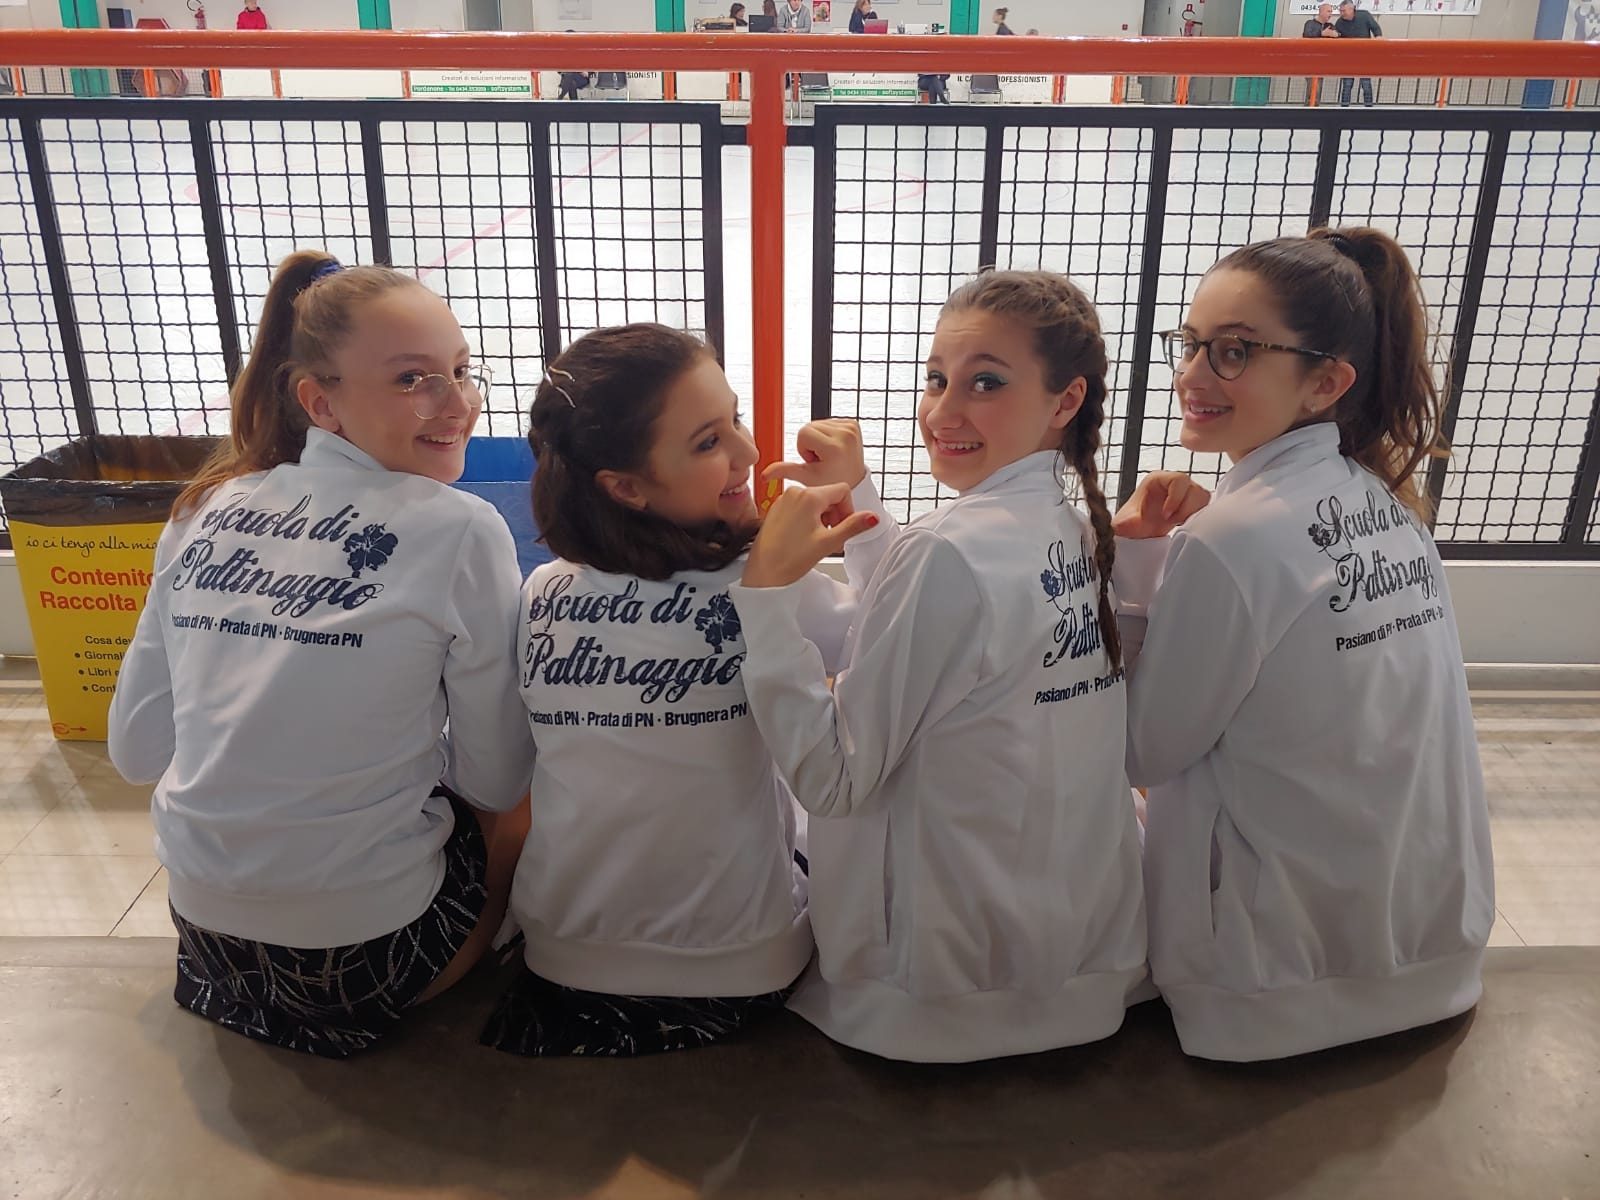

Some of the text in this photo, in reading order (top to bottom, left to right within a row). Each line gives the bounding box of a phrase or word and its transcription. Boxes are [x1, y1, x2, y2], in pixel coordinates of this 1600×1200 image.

[201, 493, 360, 542] Scuola di
[1316, 489, 1390, 551] Scuola
[26, 536, 39, 547] io
[43, 537, 57, 548] ci
[61, 536, 95, 558] tengo
[99, 536, 130, 549] alla
[173, 538, 385, 618] Pattinaggio
[40, 591, 137, 611] Raccolta
[526, 573, 697, 630] Scuola di
[85, 635, 112, 645] Cosa
[199, 615, 214, 631] PN
[219, 617, 250, 636] Prata
[251, 622, 261, 636] di
[261, 623, 277, 639] PN
[283, 629, 343, 646] Brugnera
[341, 632, 363, 648] PN
[1335, 630, 1377, 652] Pasiano
[1395, 613, 1422, 632] Prata
[88, 668, 112, 676] Libri
[523, 632, 748, 704] Pattinaggio
[1034, 684, 1071, 706] Pasiano
[1077, 678, 1089, 695] PN
[554, 710, 564, 726] di
[564, 710, 579, 726] PN
[587, 711, 620, 727] Prata
[621, 710, 633, 728] di
[634, 712, 654, 727] PN
[664, 706, 729, 729] Brugnera
[730, 702, 748, 721] PN
